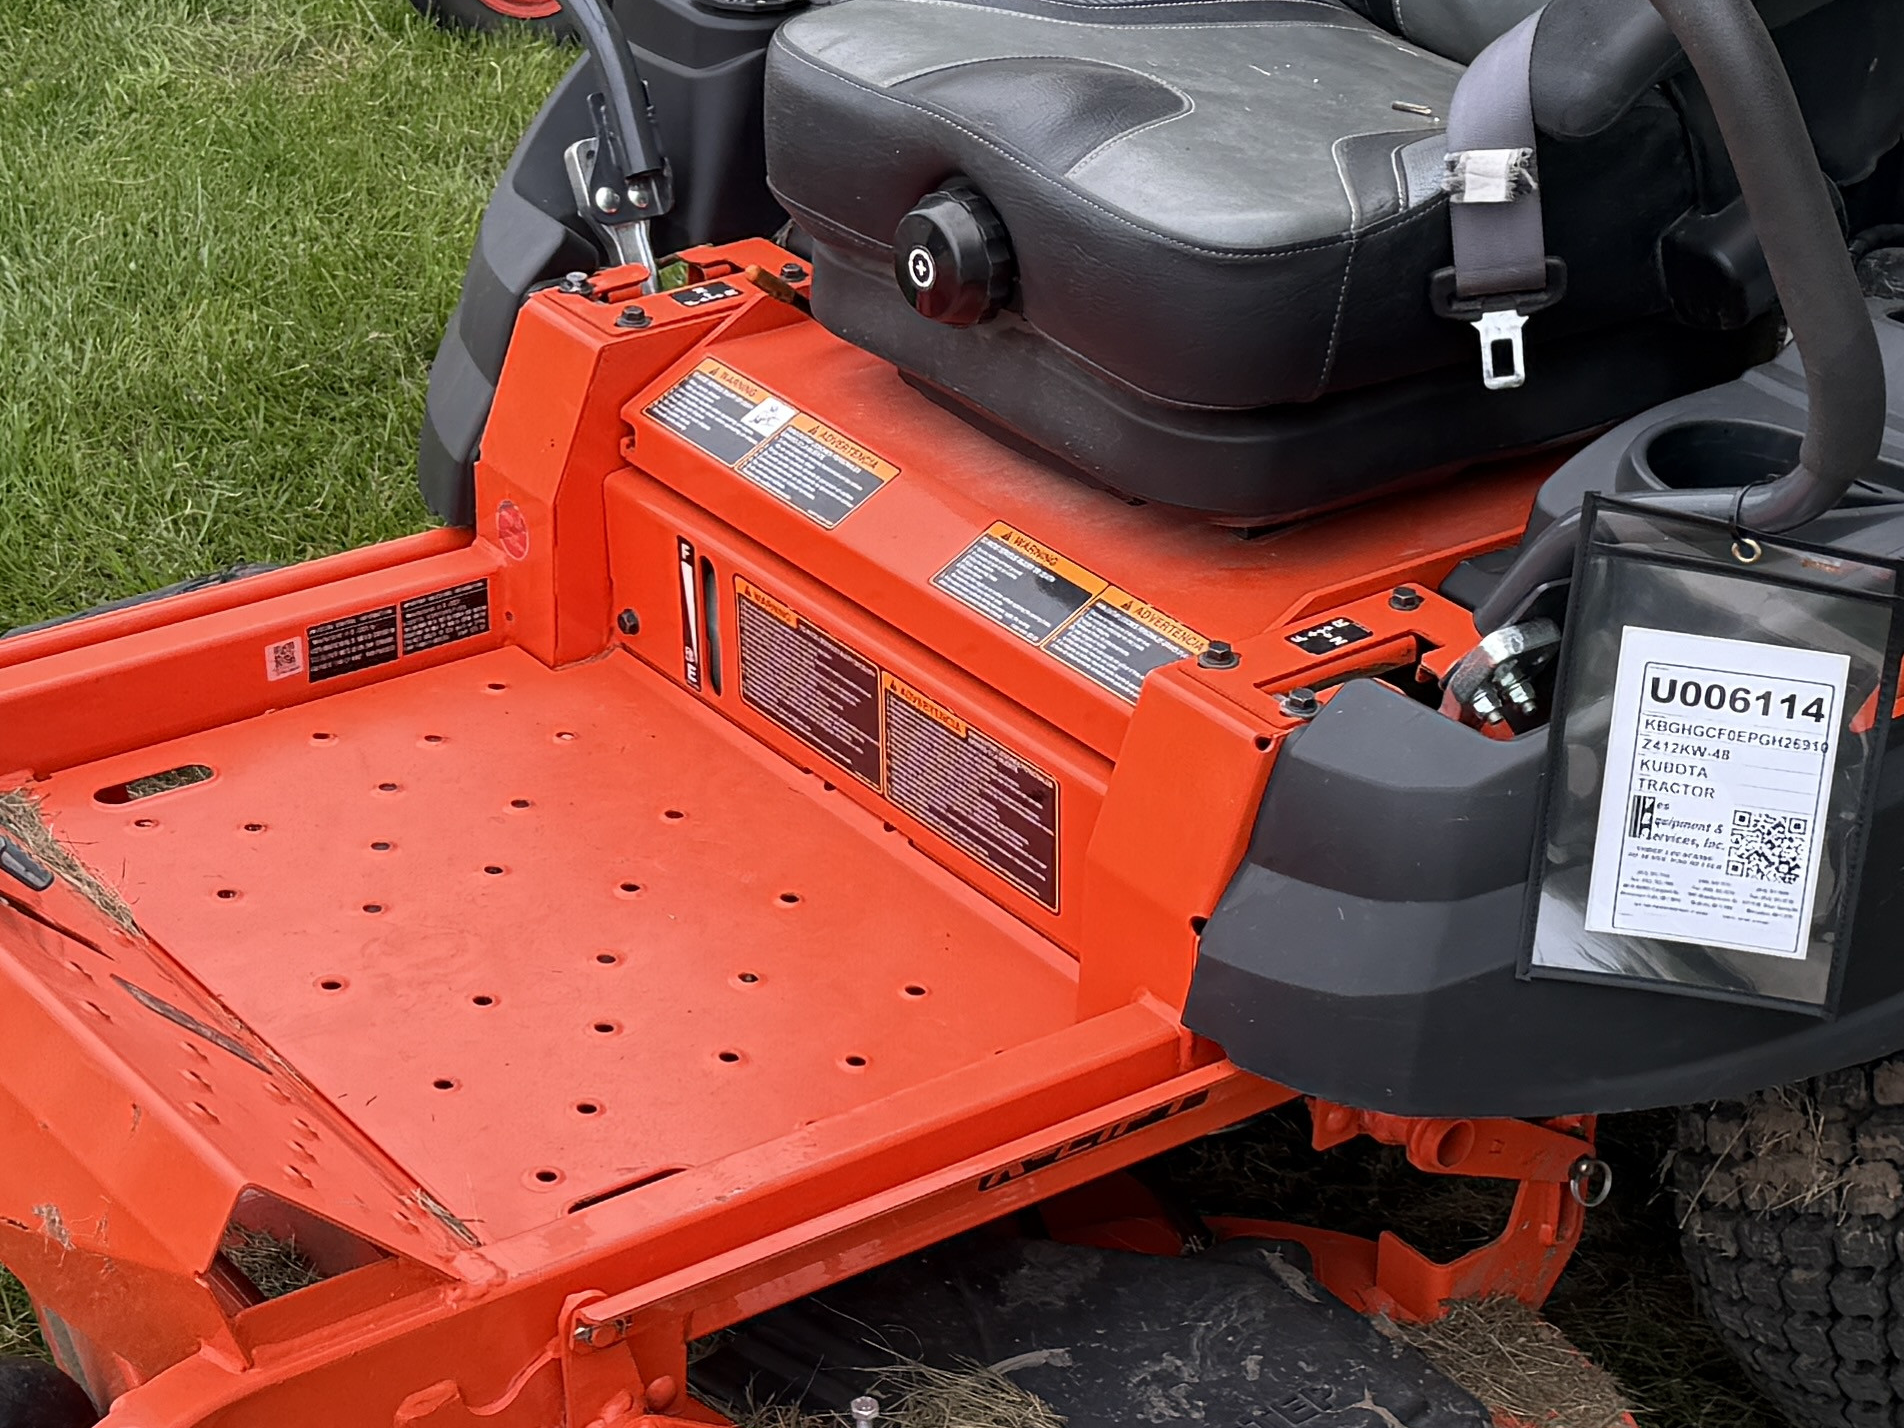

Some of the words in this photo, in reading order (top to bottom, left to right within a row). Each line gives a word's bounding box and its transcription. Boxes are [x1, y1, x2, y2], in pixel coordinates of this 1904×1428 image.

[681, 543, 691, 560] F
[1013, 533, 1059, 567] WARNING
[1134, 599, 1206, 653] ADVERTENCIA
[1650, 676, 1825, 723] U006114
[1638, 778, 1716, 799] TRACTOR
